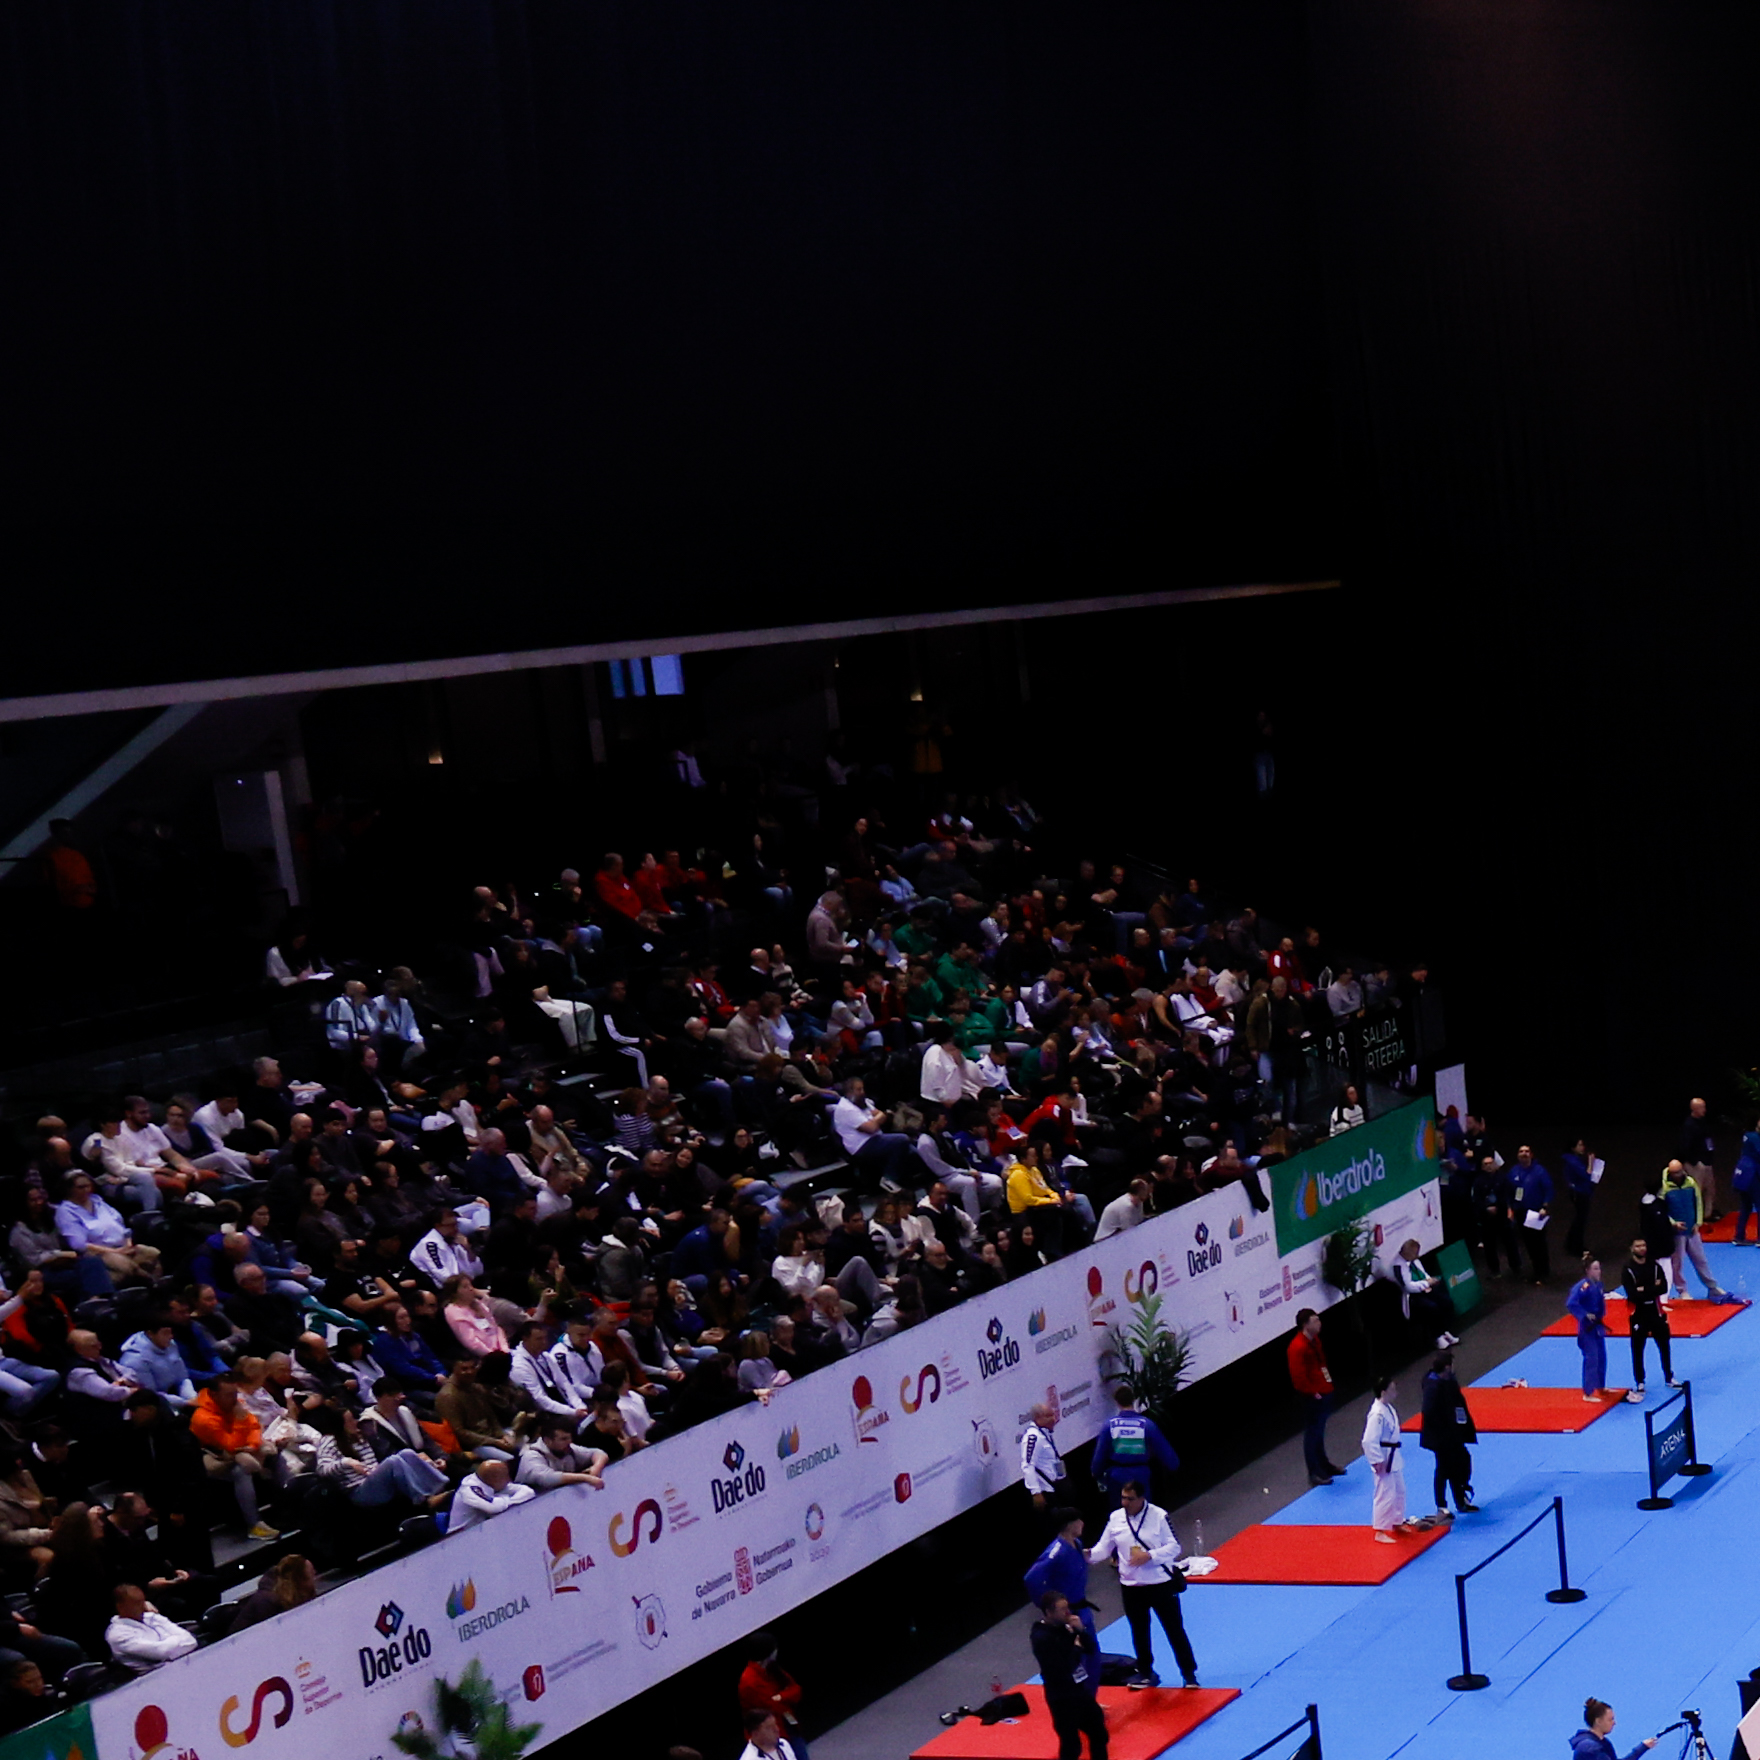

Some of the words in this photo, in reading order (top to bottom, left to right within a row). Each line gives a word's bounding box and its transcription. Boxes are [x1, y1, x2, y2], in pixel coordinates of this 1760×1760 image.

[1362, 1018, 1399, 1048] SALIDA
[1316, 1148, 1387, 1208] Iberdrola
[1187, 1241, 1223, 1278] Daedo
[977, 1336, 1020, 1380] Daedo
[711, 1463, 766, 1515] Daedo
[456, 1595, 531, 1644] IBERDROLA
[358, 1623, 432, 1688] Daedo
